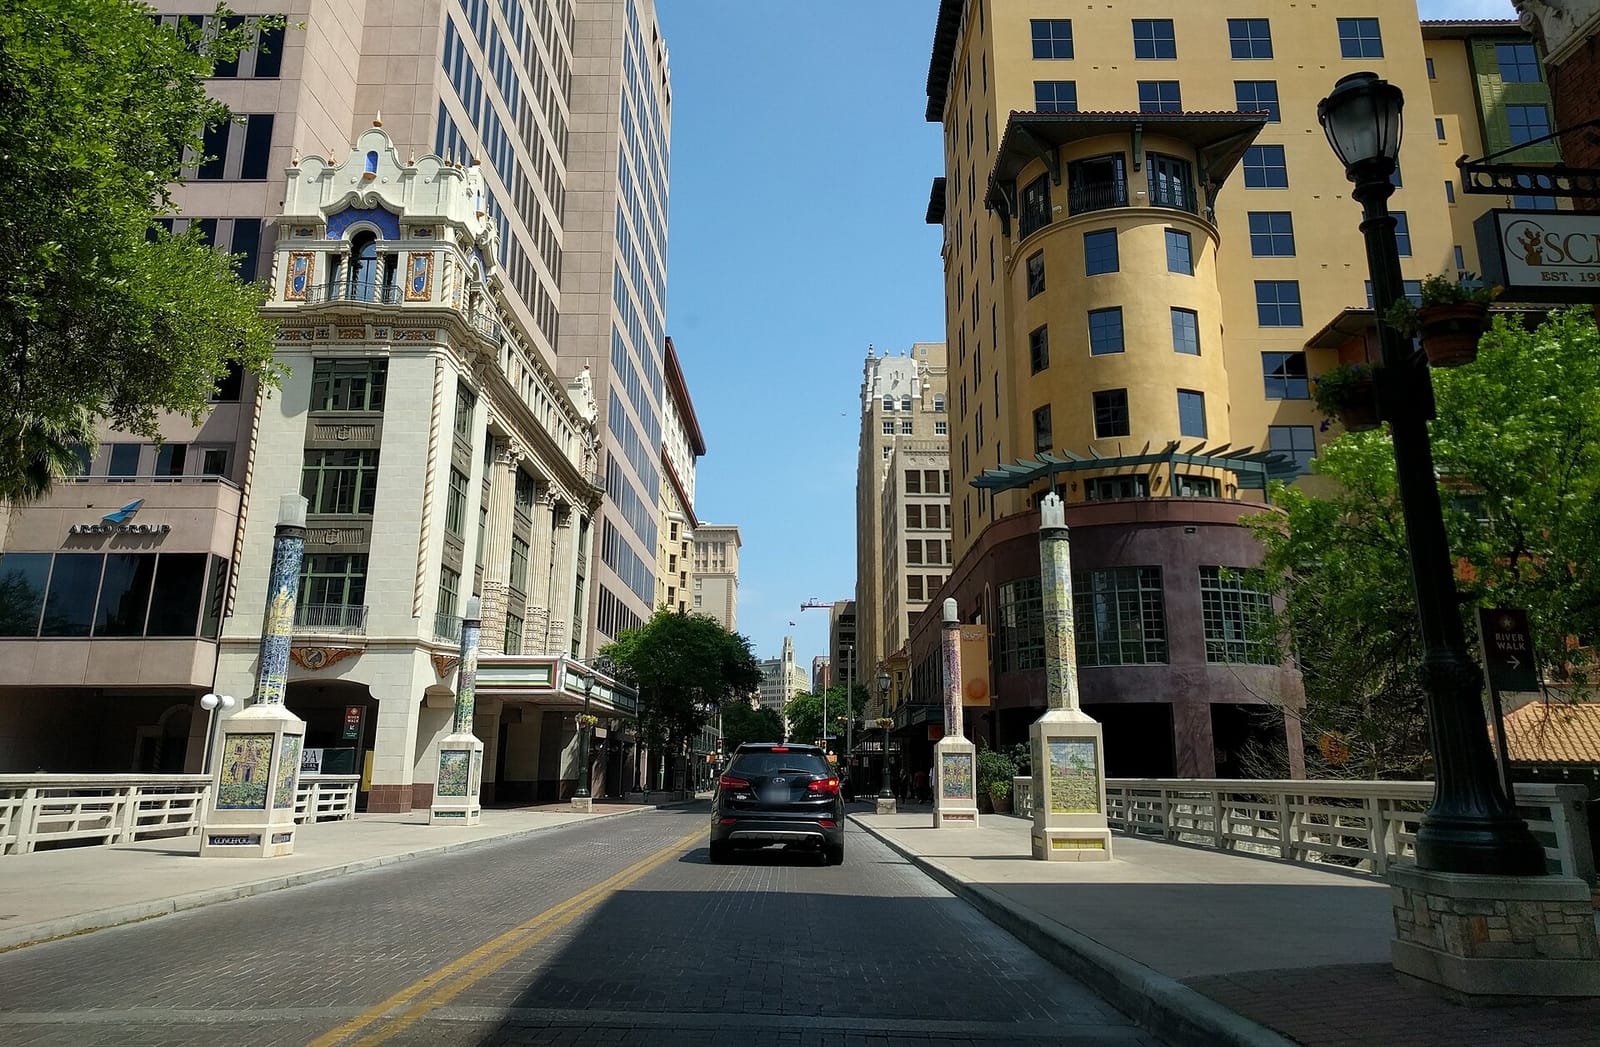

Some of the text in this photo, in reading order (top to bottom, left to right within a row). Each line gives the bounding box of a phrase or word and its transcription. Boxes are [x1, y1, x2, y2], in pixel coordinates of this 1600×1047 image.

[1541, 271, 1574, 282] EST.
[68, 524, 171, 536] ARGO GROUP
[1495, 632, 1525, 642] RIVER
[1496, 641, 1526, 651] WALK
